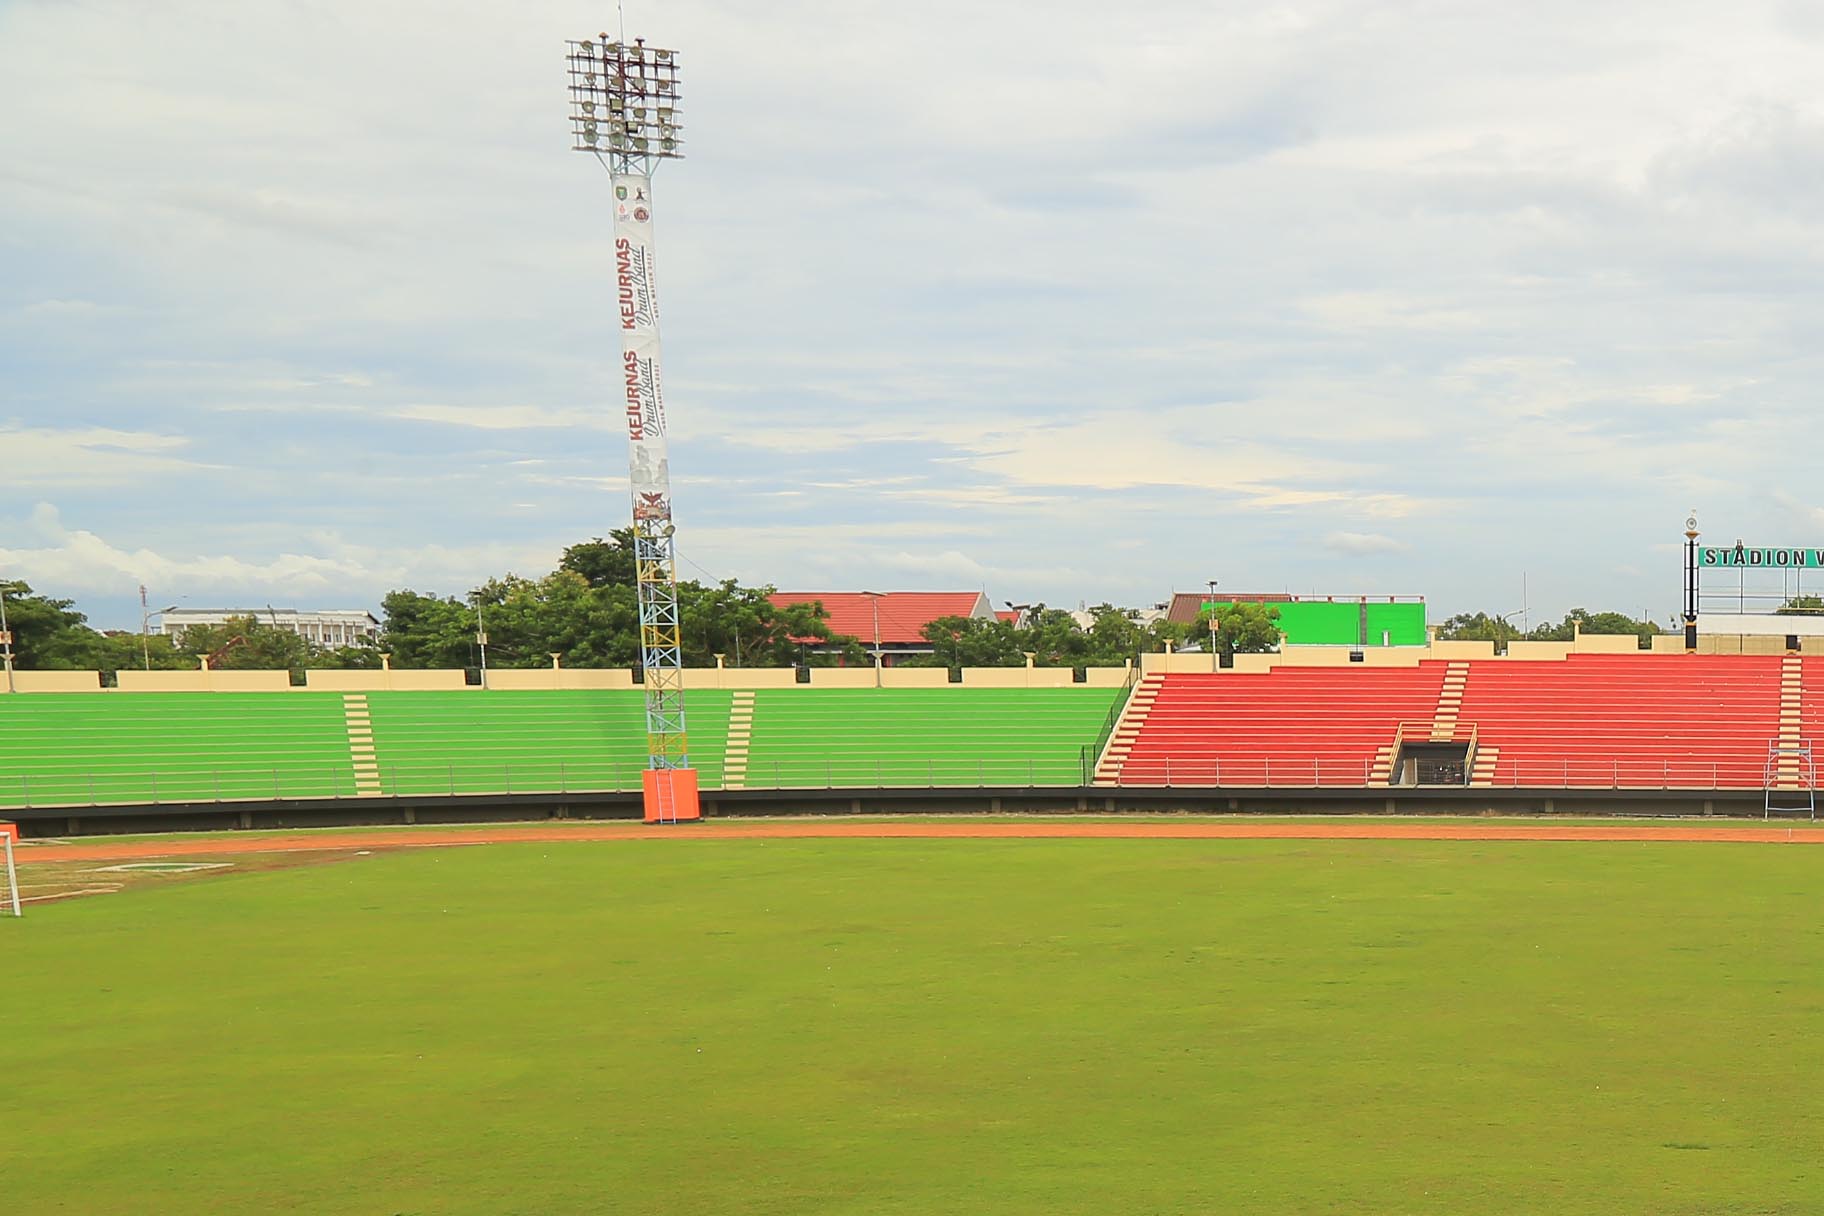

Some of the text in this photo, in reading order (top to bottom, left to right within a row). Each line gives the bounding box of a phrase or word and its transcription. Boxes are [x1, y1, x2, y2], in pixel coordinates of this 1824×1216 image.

[615, 238, 636, 330] KEJURNAS
[628, 245, 652, 326] Drum Band
[623, 350, 644, 441] KEJURNAS
[635, 358, 659, 437] Drum Band
[1704, 549, 1805, 566] STADION
